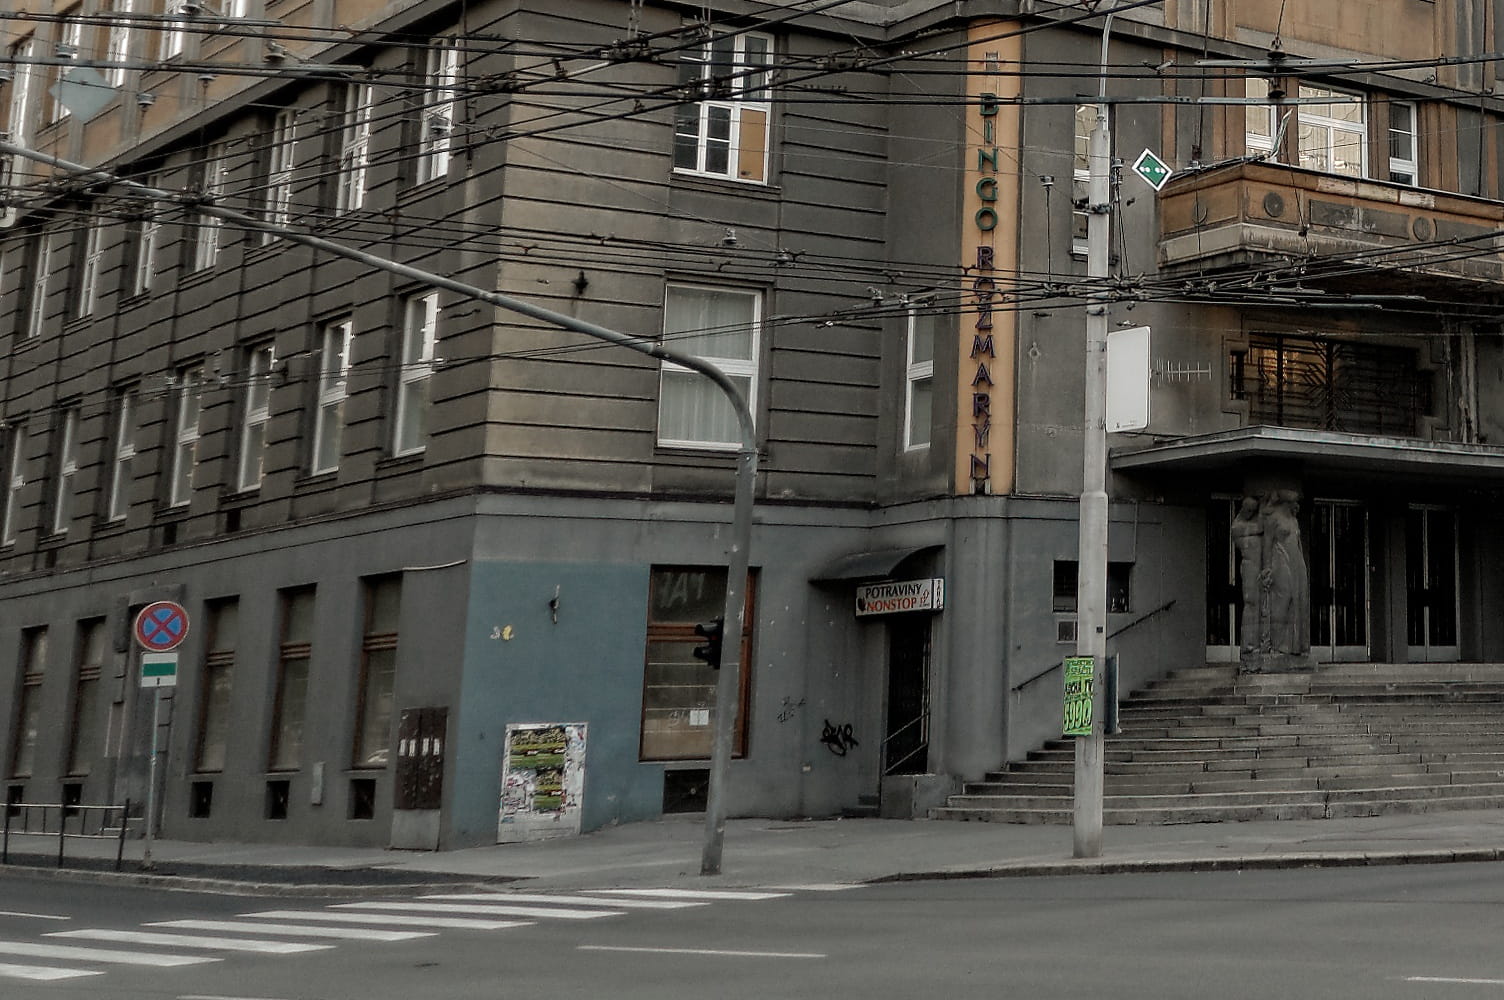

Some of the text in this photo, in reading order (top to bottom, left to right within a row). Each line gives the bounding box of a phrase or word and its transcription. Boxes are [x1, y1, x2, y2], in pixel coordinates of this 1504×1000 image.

[969, 246, 996, 478] ROZMARÝN
[865, 583, 922, 598] POTRAVINY
[867, 597, 917, 612] NONSTOP
